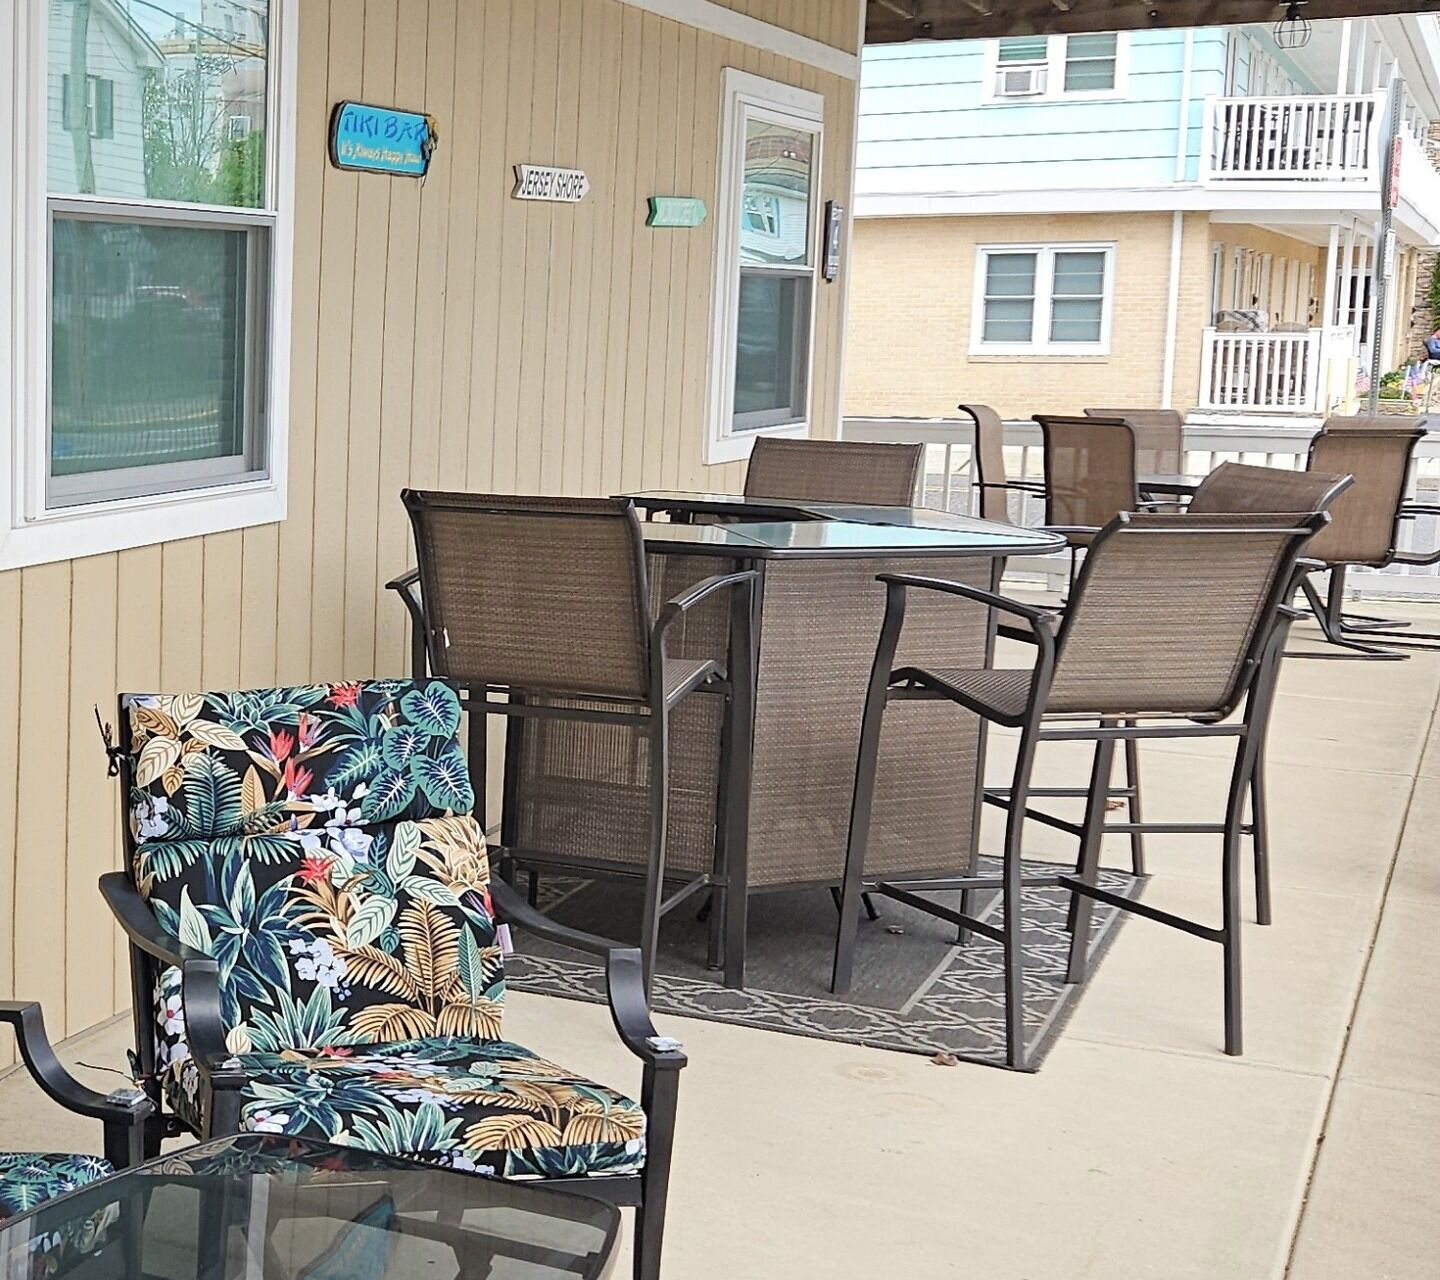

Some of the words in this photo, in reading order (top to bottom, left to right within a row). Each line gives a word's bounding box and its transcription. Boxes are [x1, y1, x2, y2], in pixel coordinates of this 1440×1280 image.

[344, 111, 378, 138] TIKI
[384, 116, 426, 142] BAR
[521, 169, 557, 197] JERSEY
[555, 172, 585, 199] SHORE
